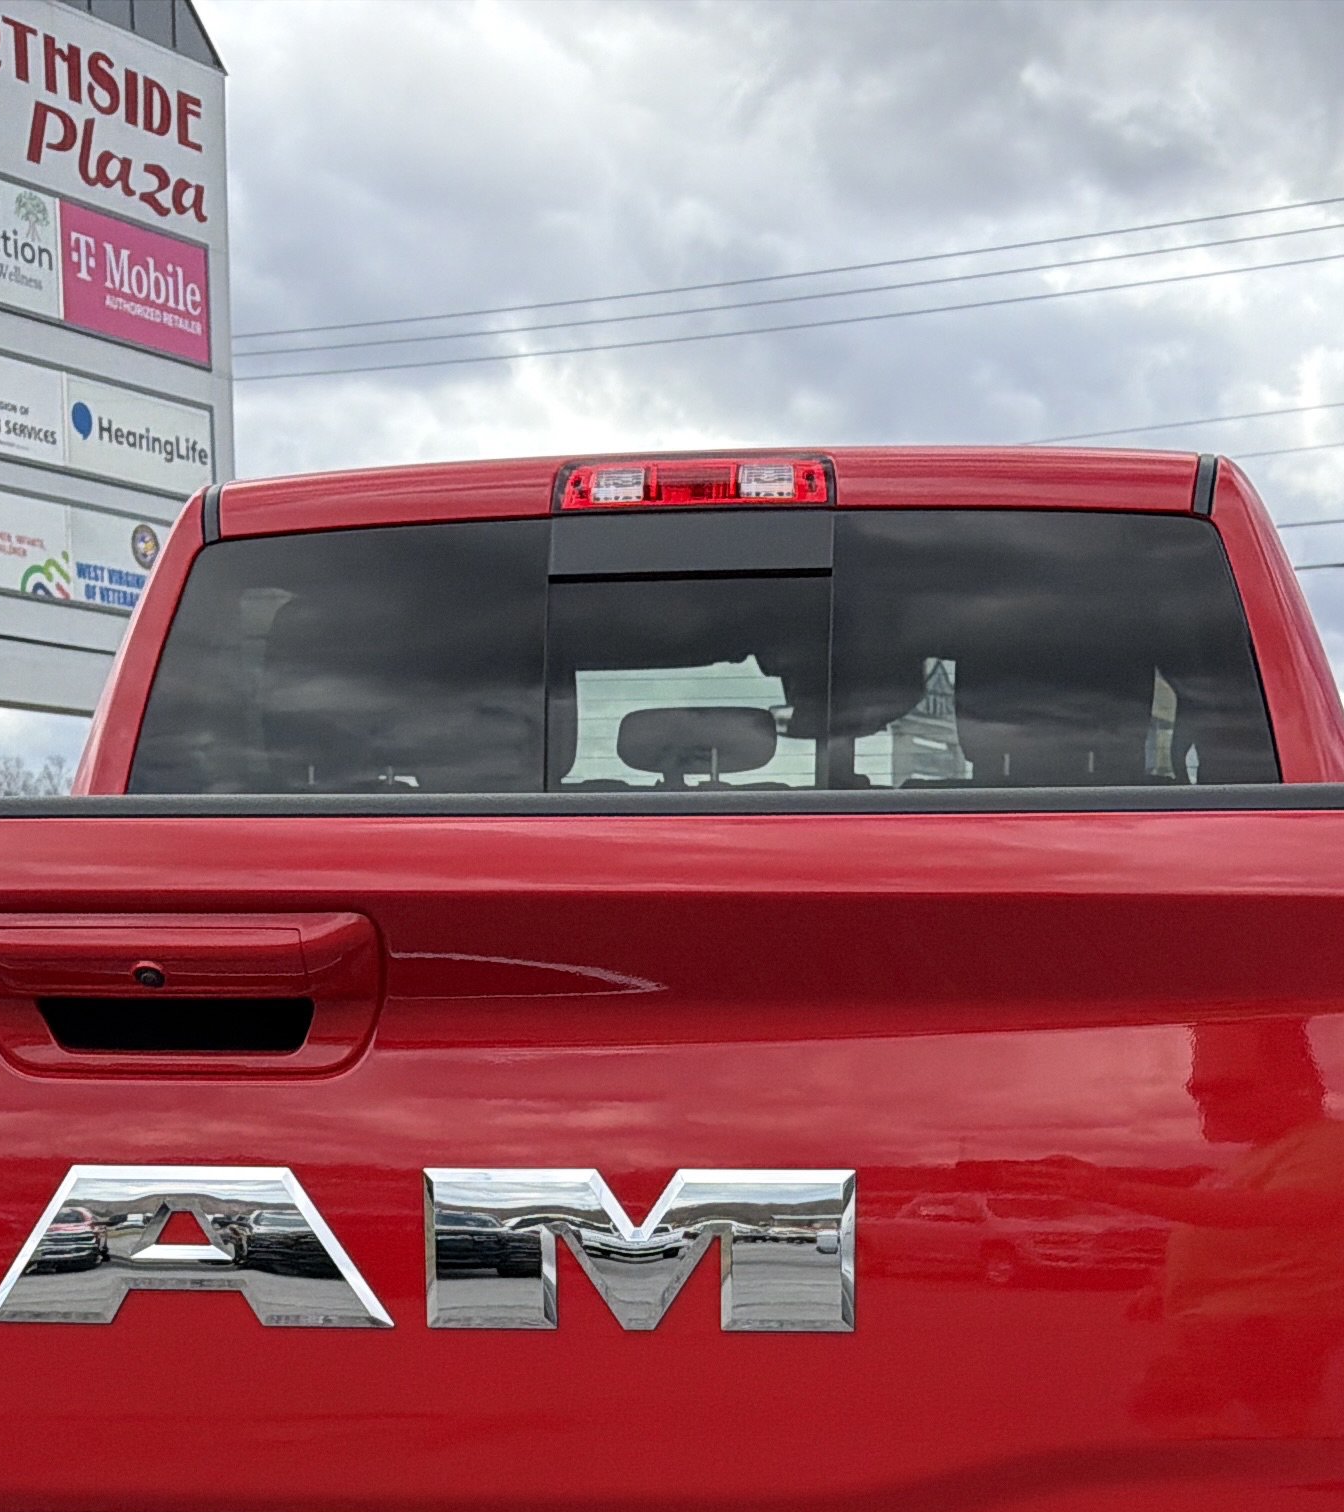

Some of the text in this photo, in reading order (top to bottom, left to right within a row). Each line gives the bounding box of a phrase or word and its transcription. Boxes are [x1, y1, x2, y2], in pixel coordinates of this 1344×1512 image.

[27, 100, 208, 223] Plaza
[102, 241, 202, 316] Mobile
[105, 294, 202, 335] AUTHORIZED RETAILER
[4, 419, 58, 446] SERVICES
[97, 415, 209, 466] HearingLife
[76, 562, 105, 583] WEST
[84, 583, 140, 608] OF VETERA
